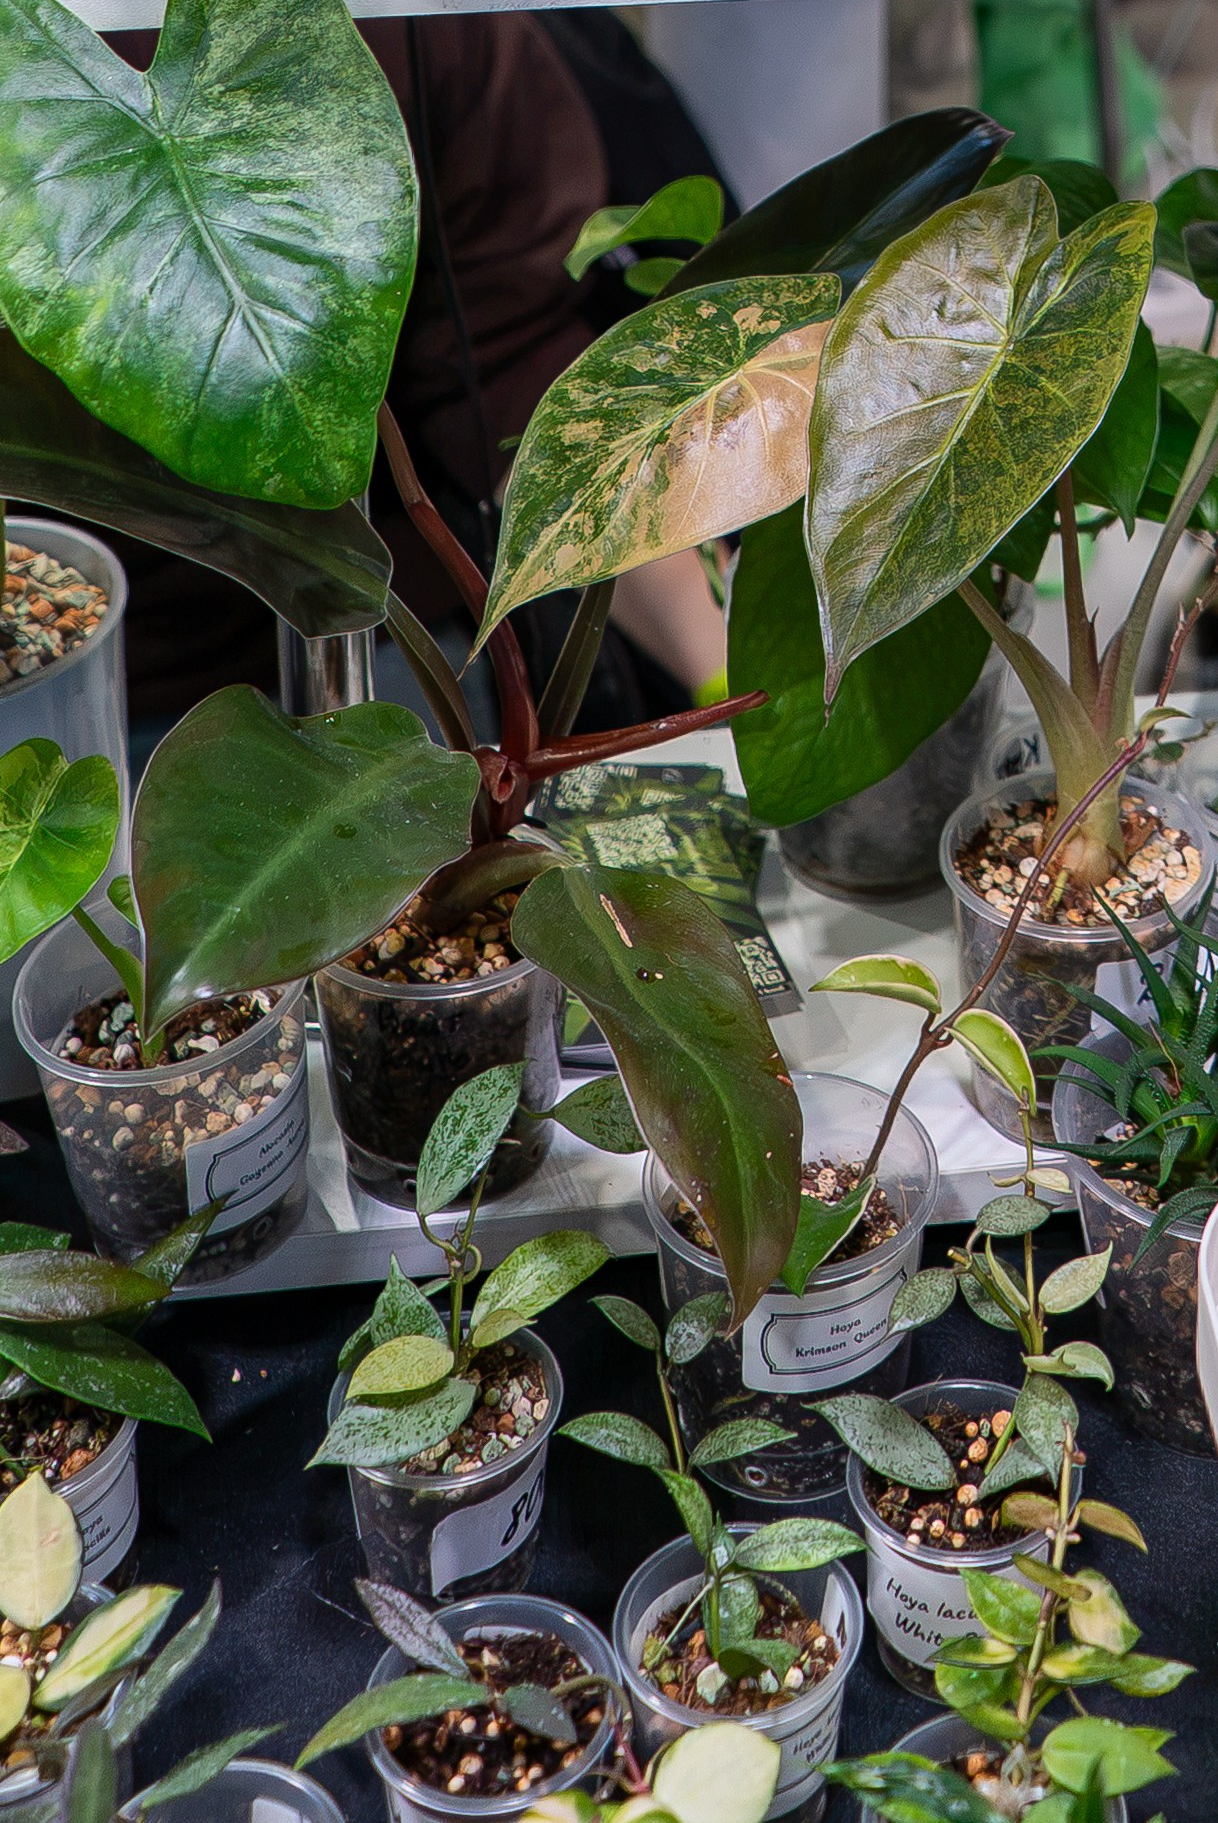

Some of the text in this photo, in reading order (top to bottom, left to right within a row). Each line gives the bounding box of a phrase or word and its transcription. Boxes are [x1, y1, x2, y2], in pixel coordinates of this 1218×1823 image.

[795, 1318, 887, 1358] Krimson Queen
[830, 1318, 861, 1335] Hoya
[886, 1577, 979, 1620] Hoya lacu
[895, 1612, 944, 1647] Whit
